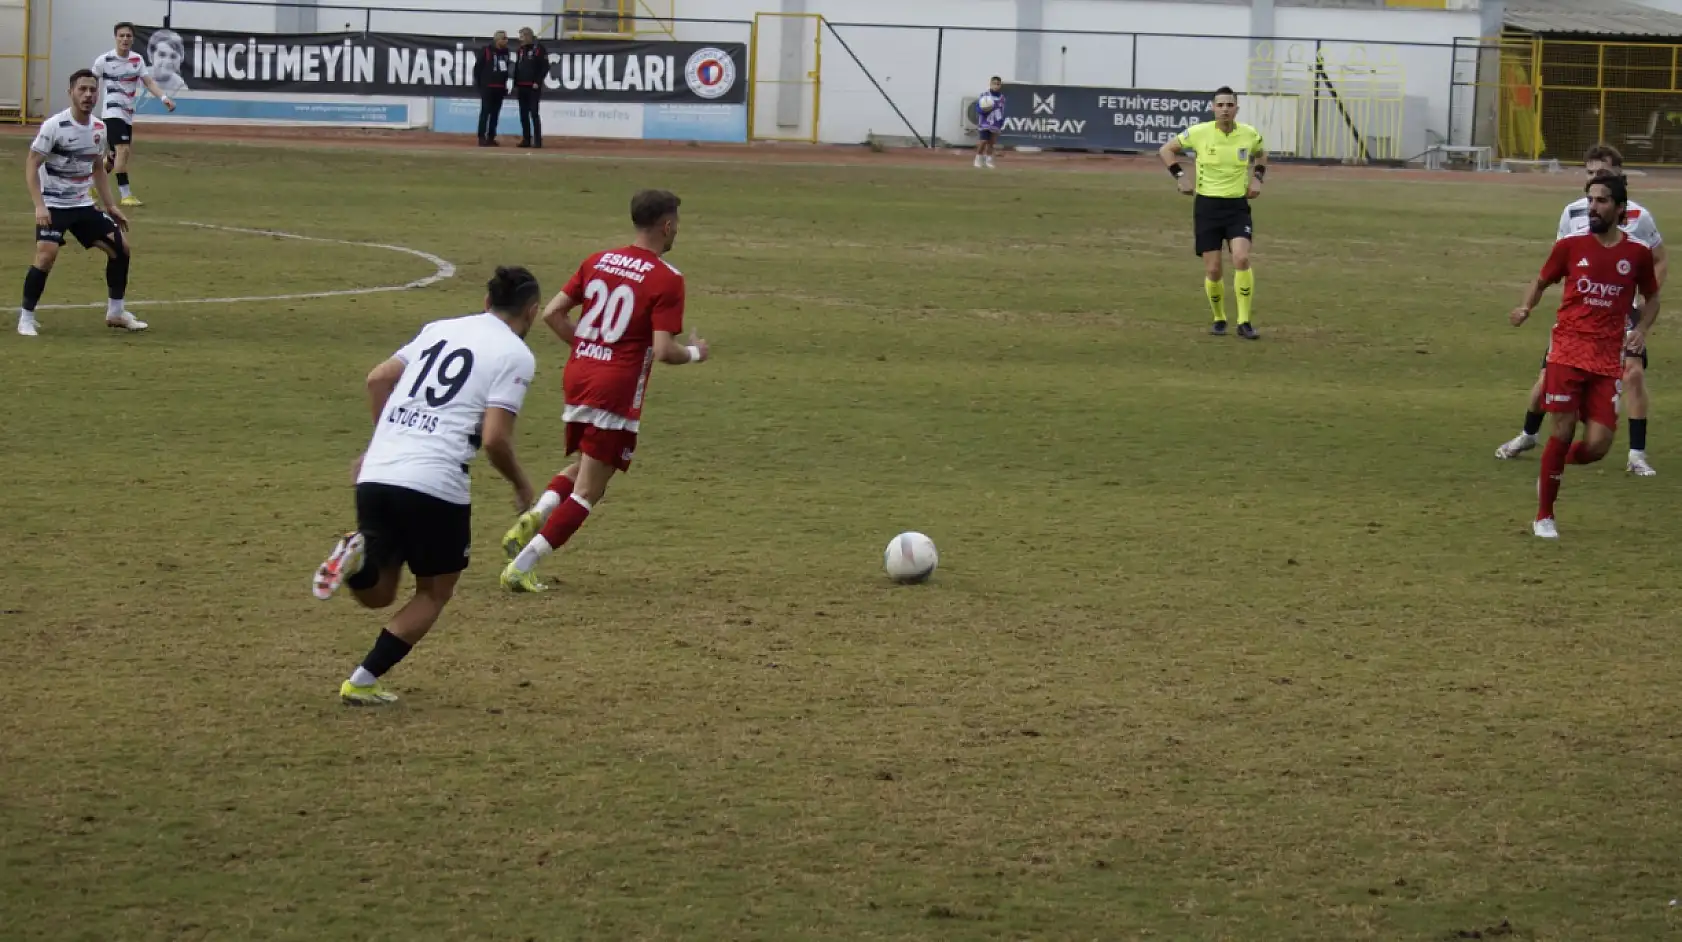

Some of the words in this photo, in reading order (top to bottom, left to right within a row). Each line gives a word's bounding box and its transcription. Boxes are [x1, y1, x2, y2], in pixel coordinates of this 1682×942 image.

[194, 35, 375, 84] İNCİTMEYİN
[506, 52, 675, 95] CUKLARI
[1098, 95, 1213, 112] FETHİYESPOR'A
[1114, 113, 1200, 129] BAŞARILAR
[600, 252, 655, 273] ESNAF
[1577, 274, 1624, 298] Özyer
[574, 278, 634, 344] 20
[408, 339, 474, 407] 19
